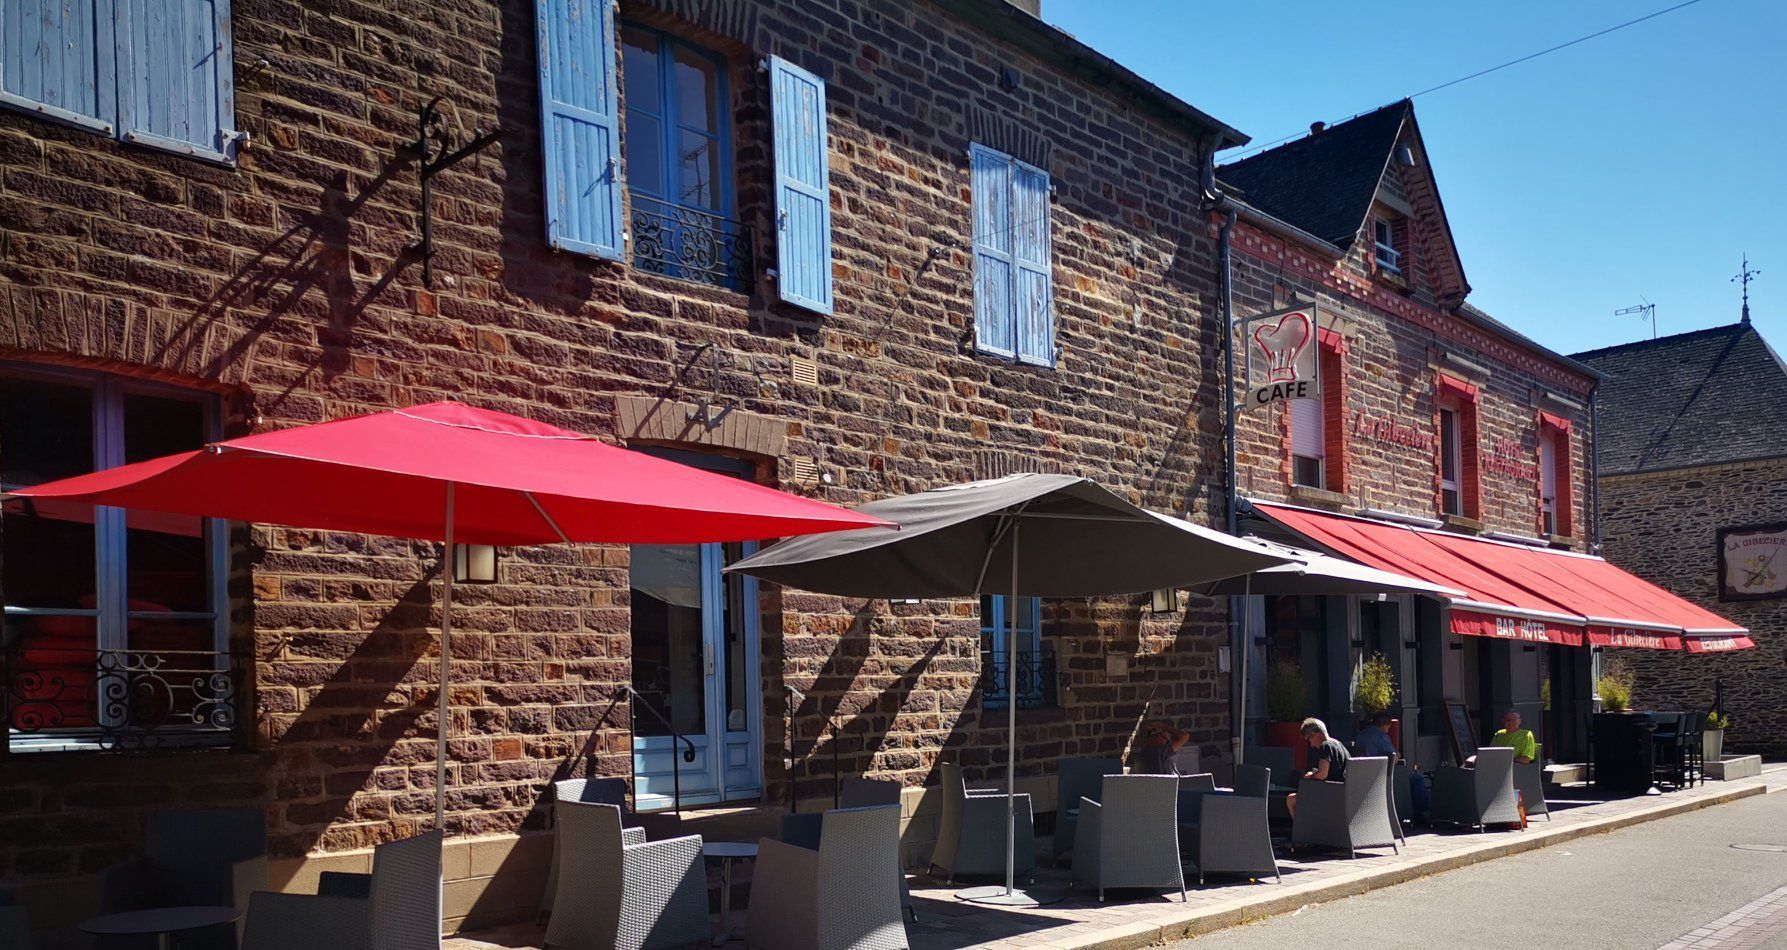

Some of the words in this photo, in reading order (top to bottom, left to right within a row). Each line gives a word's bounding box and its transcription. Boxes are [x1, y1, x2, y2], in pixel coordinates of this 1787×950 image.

[1256, 382, 1307, 403] CAFE
[1357, 407, 1375, 436] La
[1727, 542, 1740, 551] LA
[1496, 618, 1516, 637] BAR
[1520, 619, 1549, 640] HÔTEL
[1611, 628, 1623, 645] La
[1624, 629, 1660, 647] Gibecière
